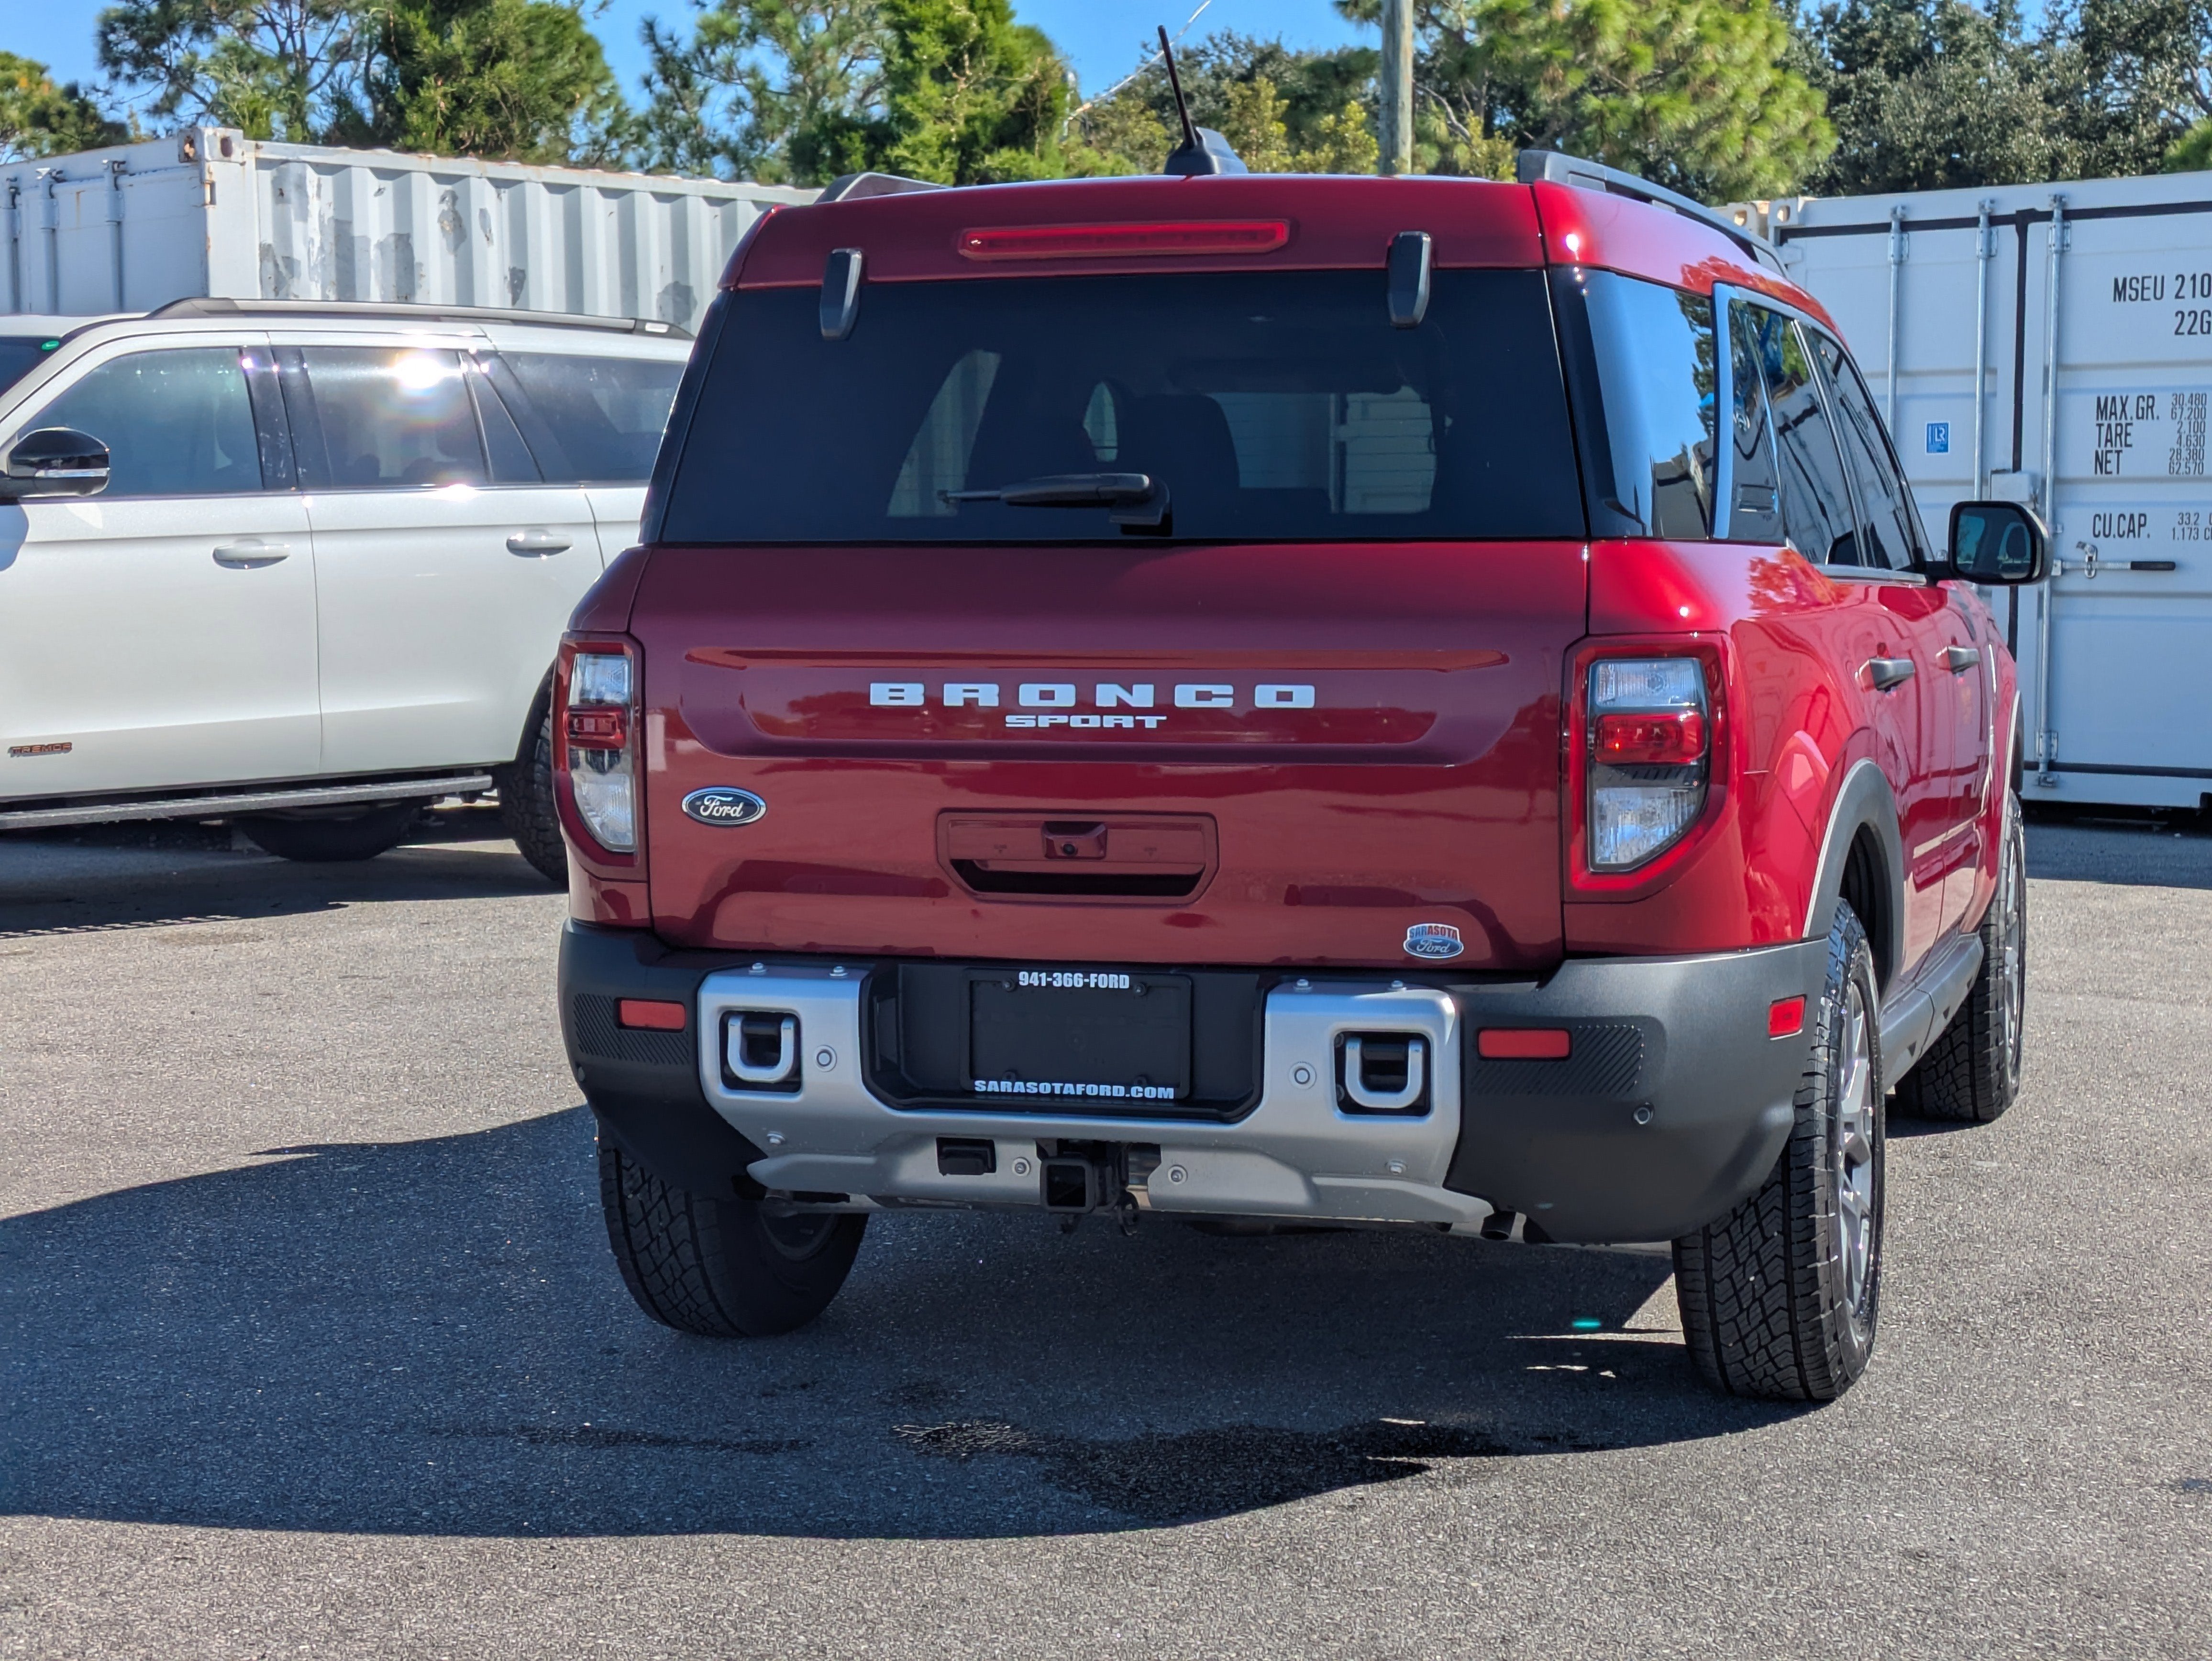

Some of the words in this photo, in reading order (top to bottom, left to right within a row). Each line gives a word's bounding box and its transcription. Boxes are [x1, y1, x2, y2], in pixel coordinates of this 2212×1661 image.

[2112, 275, 2165, 303] MSEU
[2174, 273, 2212, 299] 210
[2174, 310, 2212, 335] 22G
[2096, 395, 2160, 421] MAX.GR.
[2096, 422, 2134, 448] TARE
[2094, 449, 2123, 476] NET
[2092, 513, 2150, 539] CU.CAP.
[869, 682, 1315, 709] BRONCO
[1005, 715, 1167, 729] SPORT
[700, 795, 745, 817] Ford
[1409, 925, 1458, 941] SARASOTA
[1416, 938, 1451, 953] Ford
[1018, 971, 1130, 989] 941-366-FORD
[974, 1080, 1174, 1099] SARASOTAFORD.COM
